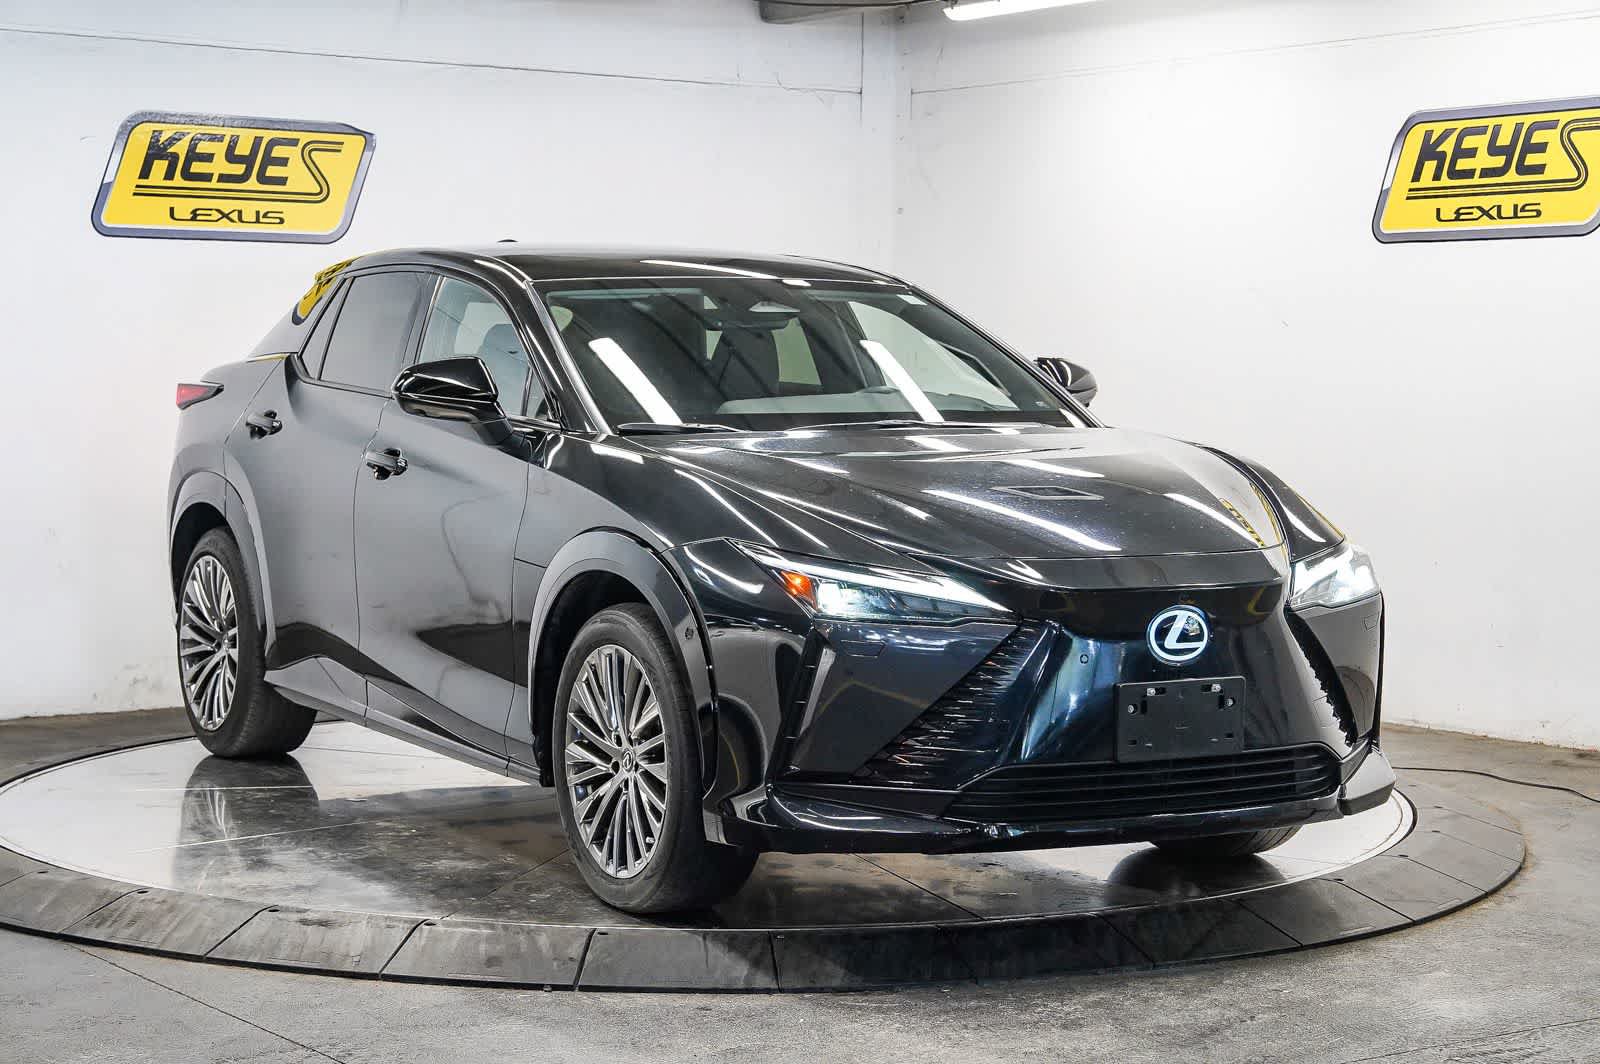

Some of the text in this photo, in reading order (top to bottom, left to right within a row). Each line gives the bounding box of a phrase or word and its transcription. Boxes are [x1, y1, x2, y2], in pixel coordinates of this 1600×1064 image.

[133, 130, 344, 203] KEYES
[1406, 117, 1600, 200] KEYES
[169, 206, 285, 225] LEXUS
[1436, 203, 1542, 222] LEXUS
